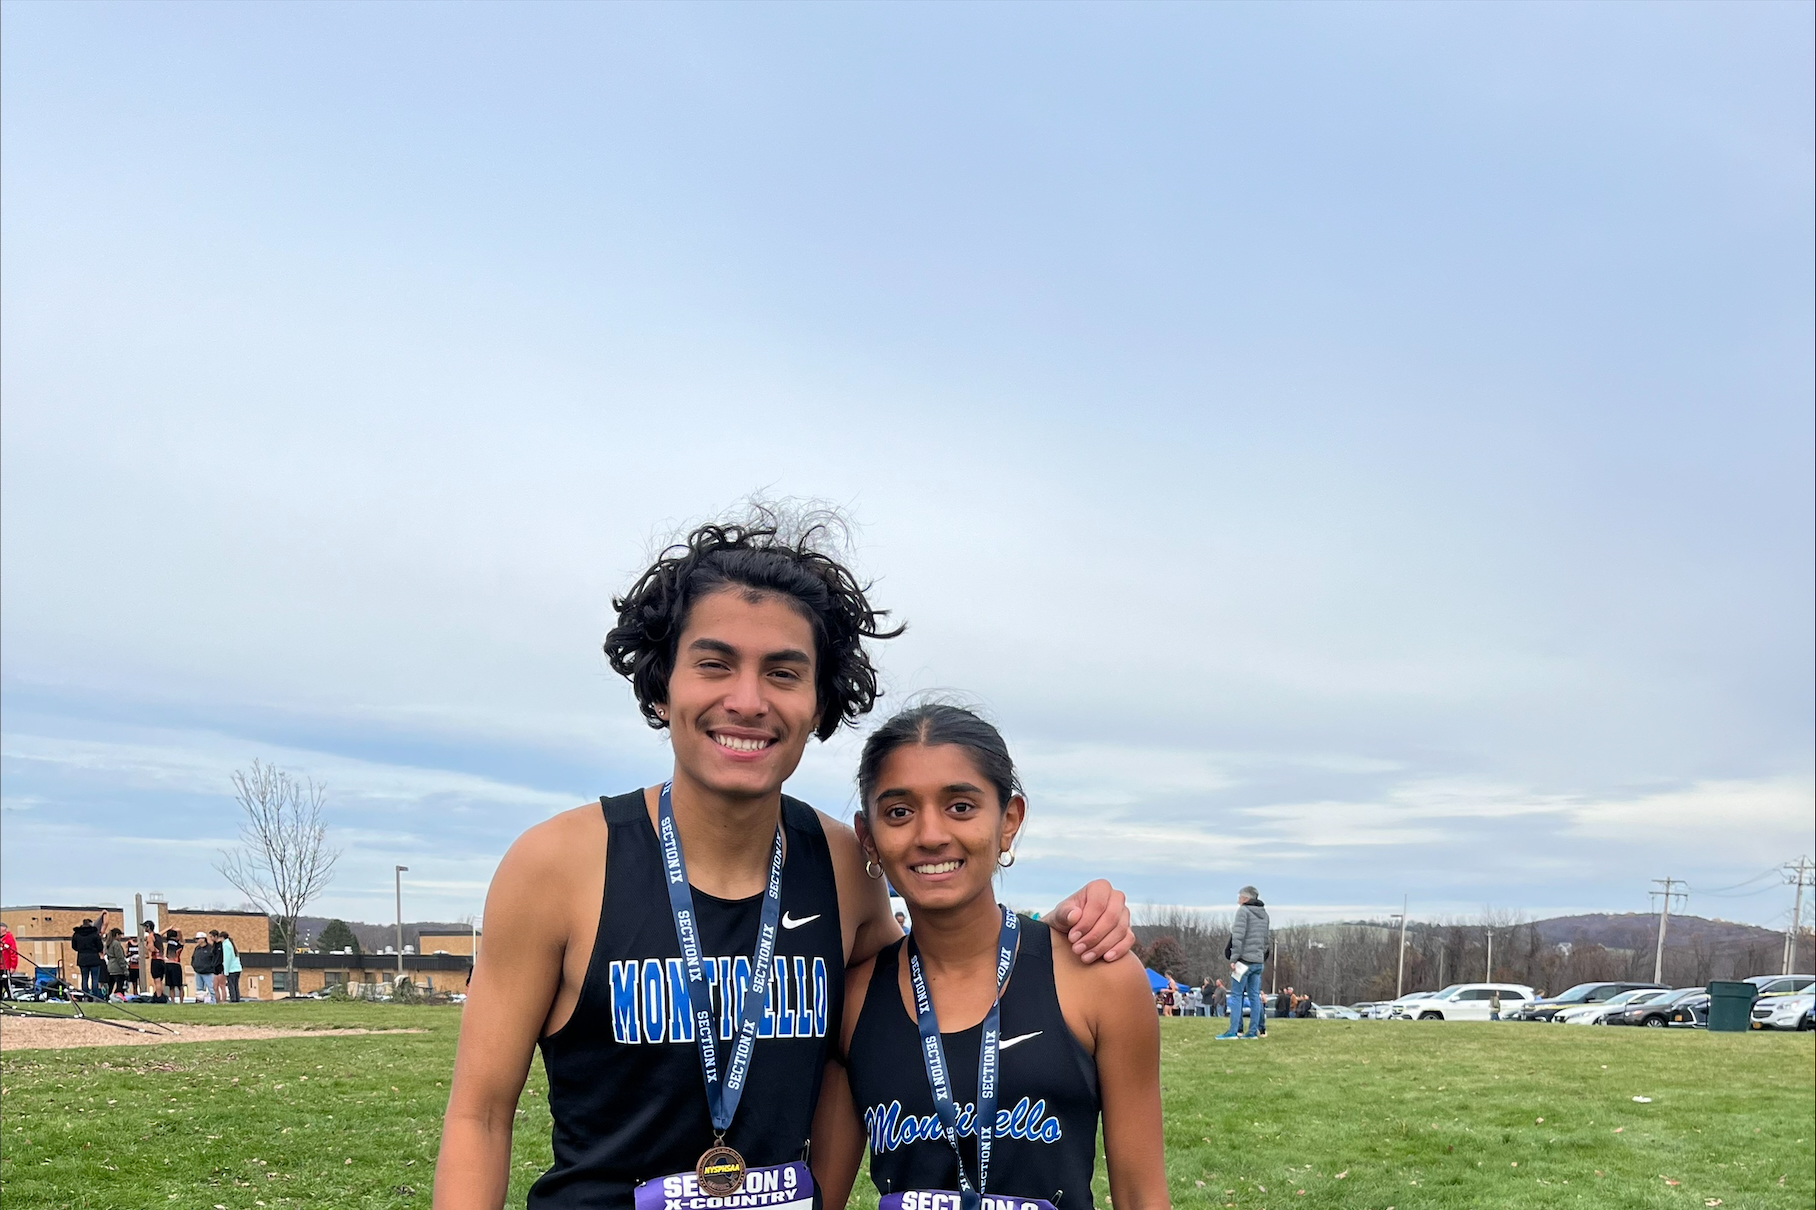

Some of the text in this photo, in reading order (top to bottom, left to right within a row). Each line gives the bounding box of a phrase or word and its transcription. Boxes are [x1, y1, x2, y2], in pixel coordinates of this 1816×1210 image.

[864, 1096, 1062, 1155] Moniello
[663, 1169, 779, 1199] SEON
[783, 1166, 797, 1189] 9
